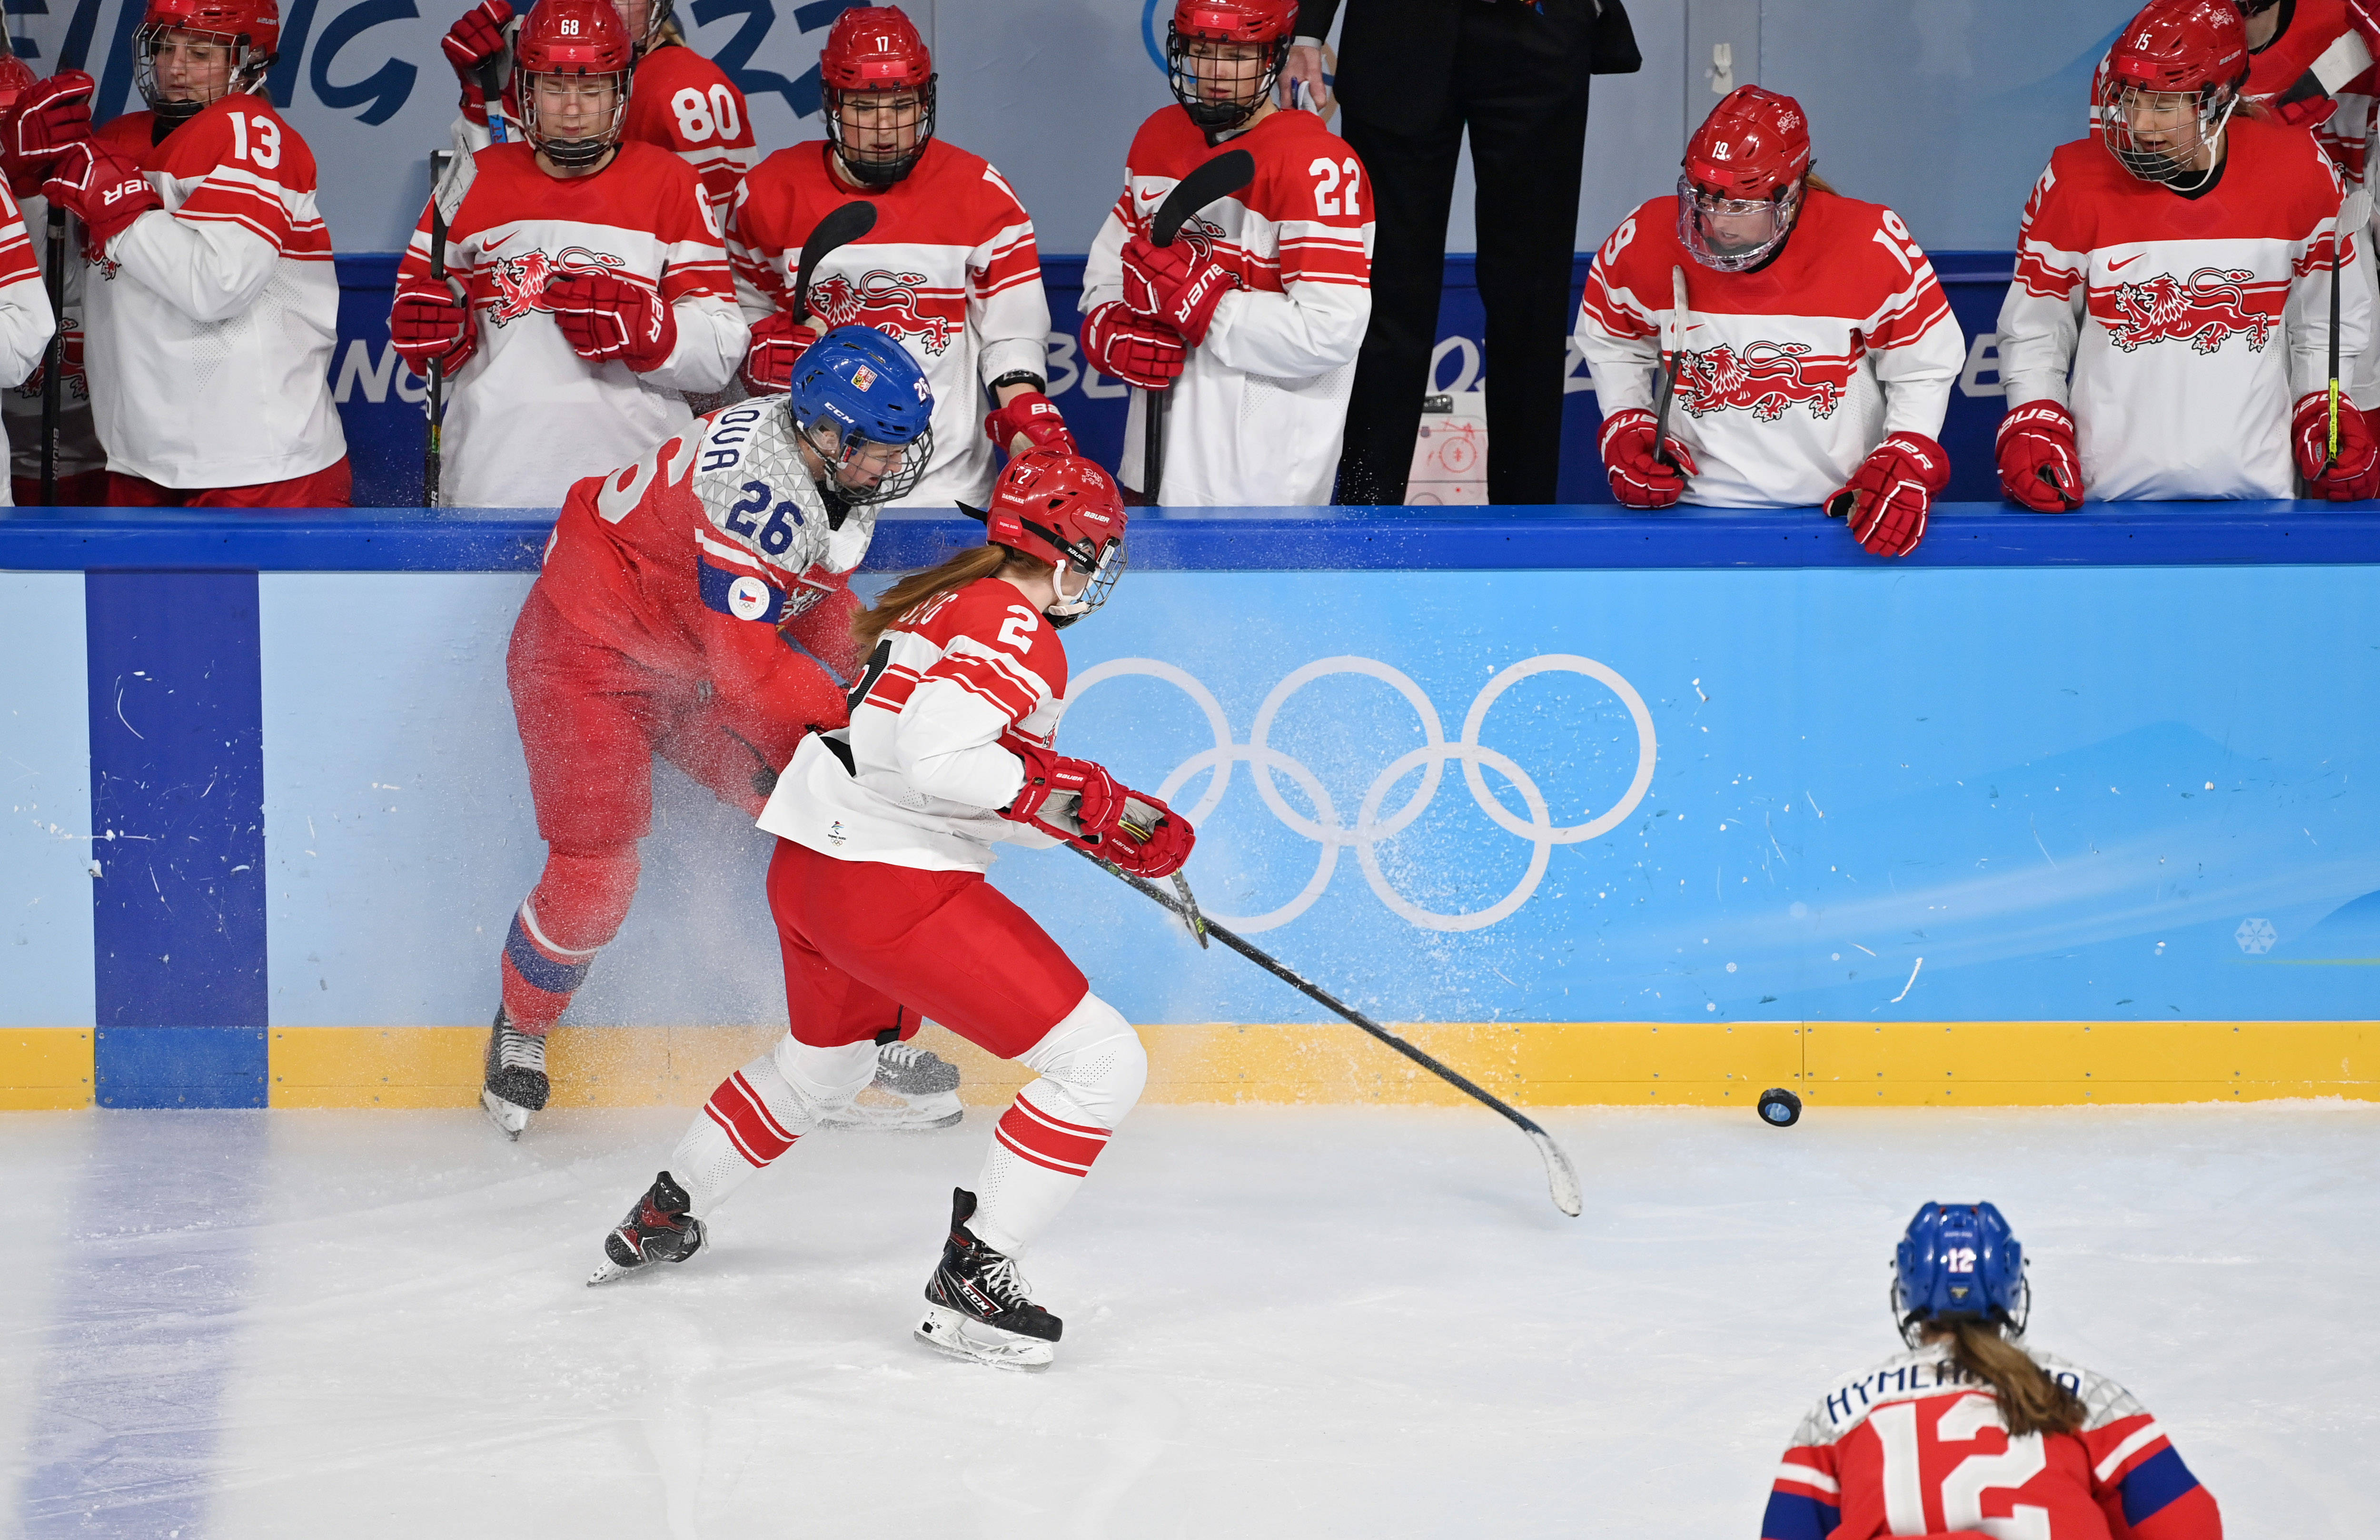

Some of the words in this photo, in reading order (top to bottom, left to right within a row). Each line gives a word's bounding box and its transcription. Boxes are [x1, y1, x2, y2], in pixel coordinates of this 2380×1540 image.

[561, 19, 579, 35] 68
[875, 36, 889, 52] 17
[2135, 33, 2152, 50] 15
[671, 83, 741, 142] 80
[227, 111, 281, 170] 13
[1712, 141, 1728, 160] 19
[1308, 157, 1360, 217] 22
[1872, 210, 1923, 275] 19
[913, 377, 931, 402] 26
[824, 402, 855, 424] CCM
[1017, 469, 1032, 484] 2
[1002, 493, 1024, 504] DANMARK
[725, 480, 805, 556] 26
[1083, 511, 1110, 523] BAUER
[1067, 547, 1088, 563] BAUER
[997, 604, 1039, 655] 2
[1056, 772, 1084, 782] BAUER
[1022, 790, 1037, 814] BAUER
[1112, 837, 1135, 854] BAUER
[1948, 1247, 1977, 1273] 12
[961, 1285, 991, 1311] CCM
[1868, 1393, 2053, 1540] 12
